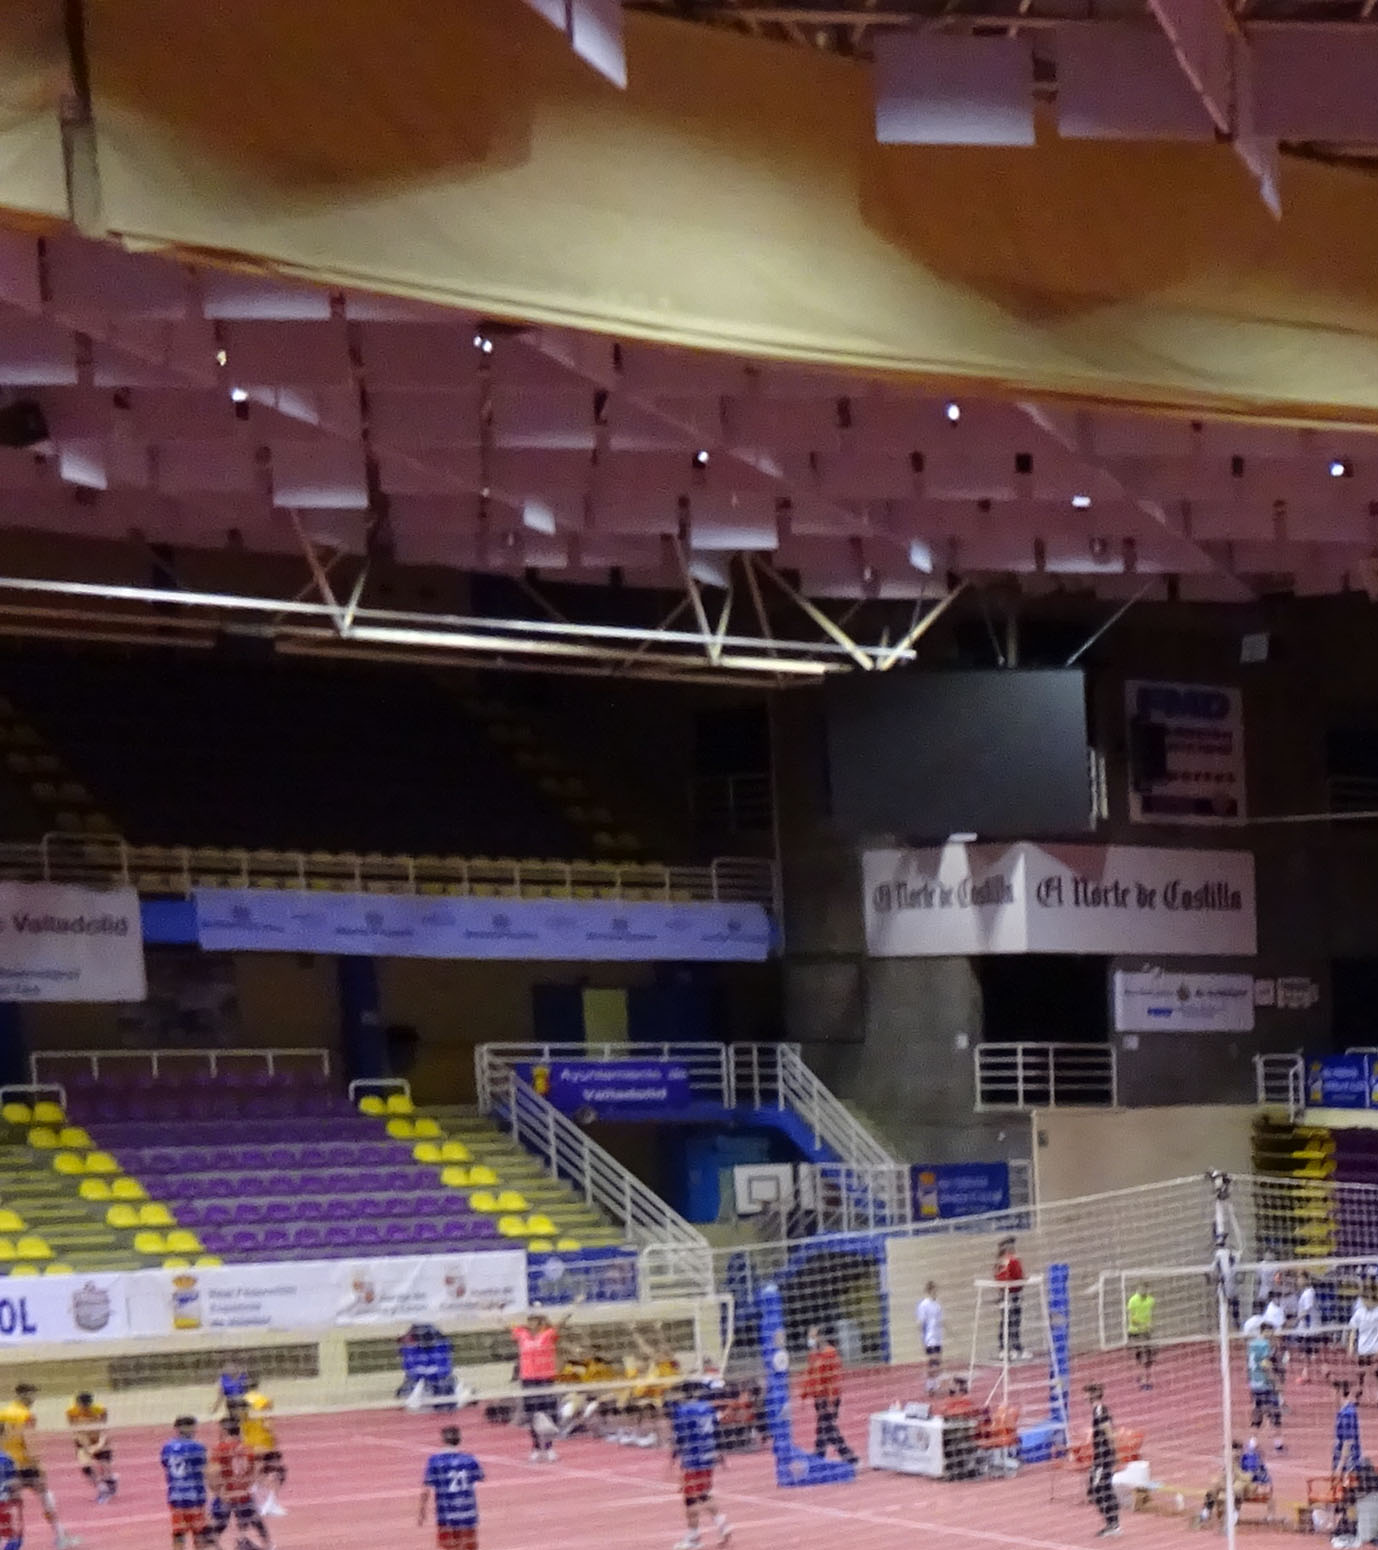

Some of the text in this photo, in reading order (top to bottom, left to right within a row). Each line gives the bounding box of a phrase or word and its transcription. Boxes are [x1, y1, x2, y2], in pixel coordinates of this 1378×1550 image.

[1036, 876, 1243, 912] El Norte de Castilla
